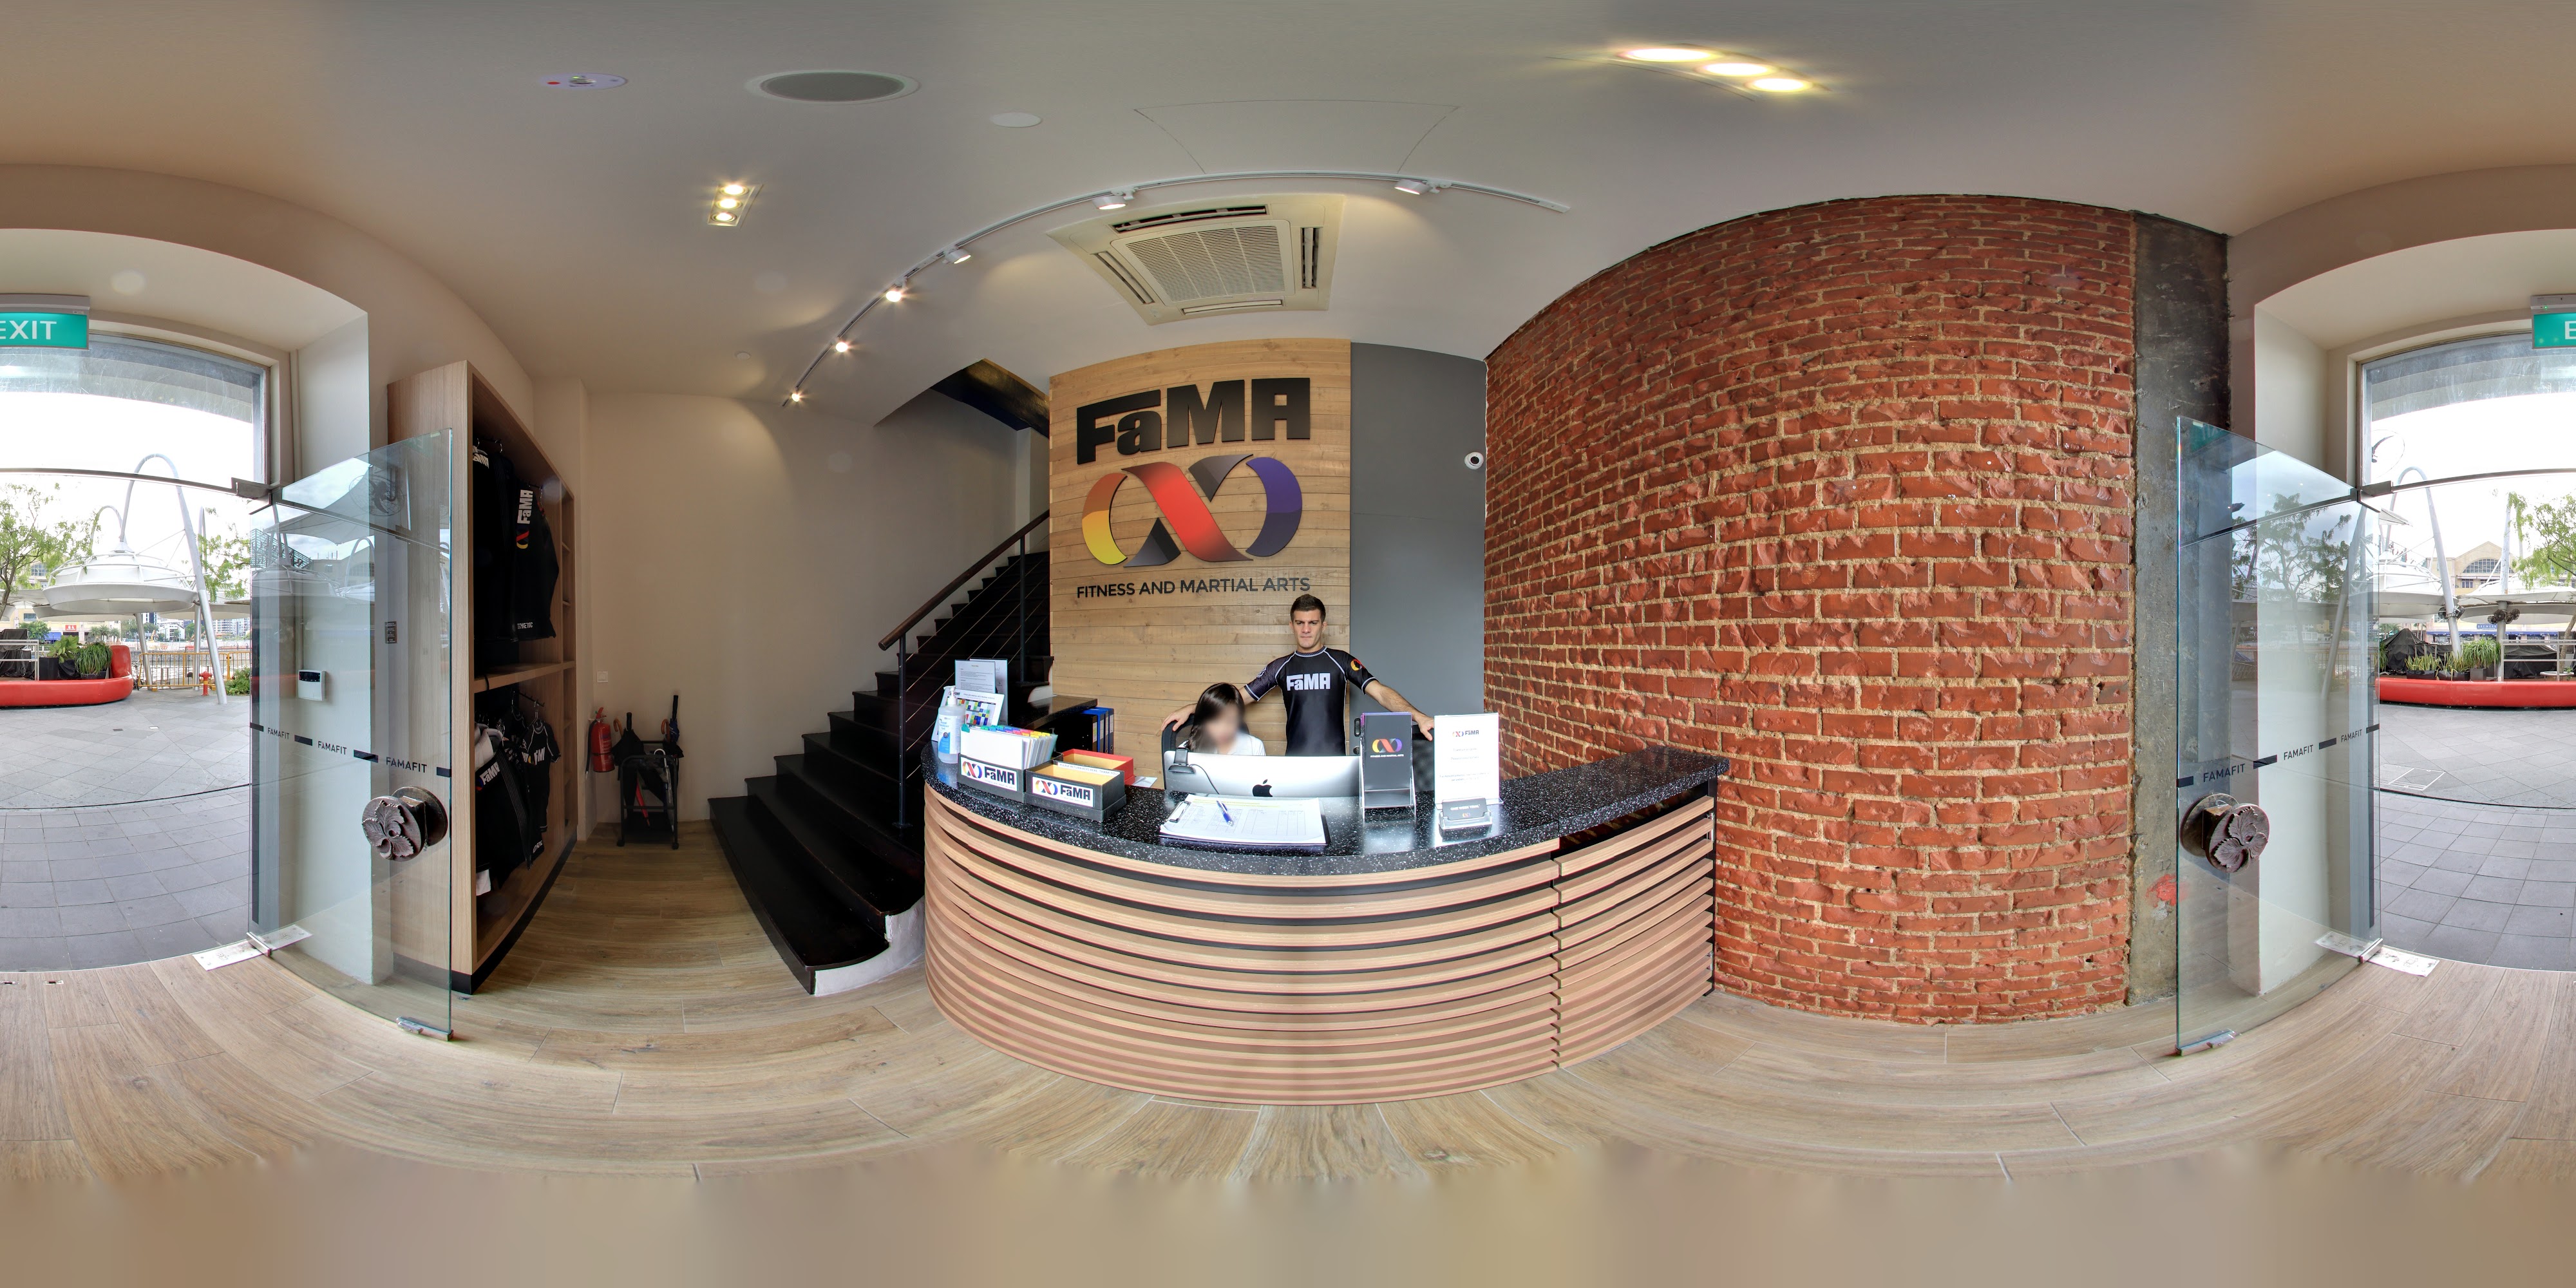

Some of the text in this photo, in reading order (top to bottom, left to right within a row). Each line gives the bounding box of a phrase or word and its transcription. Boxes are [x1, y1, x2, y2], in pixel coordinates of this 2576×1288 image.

[1077, 377, 1311, 465] FaMA
[517, 489, 533, 524] FaMA
[1077, 577, 1311, 598] FITNESS AND MARTIAL ARTS
[1286, 673, 1331, 691] FaMA
[267, 727, 428, 773] FAMAFIT FAMAFIT FAMAFIT
[2203, 729, 2362, 782] FAMAFIT FAMAFIT FAMAFIT
[984, 766, 1015, 785] FaMA
[1060, 784, 1091, 800] FaMA
